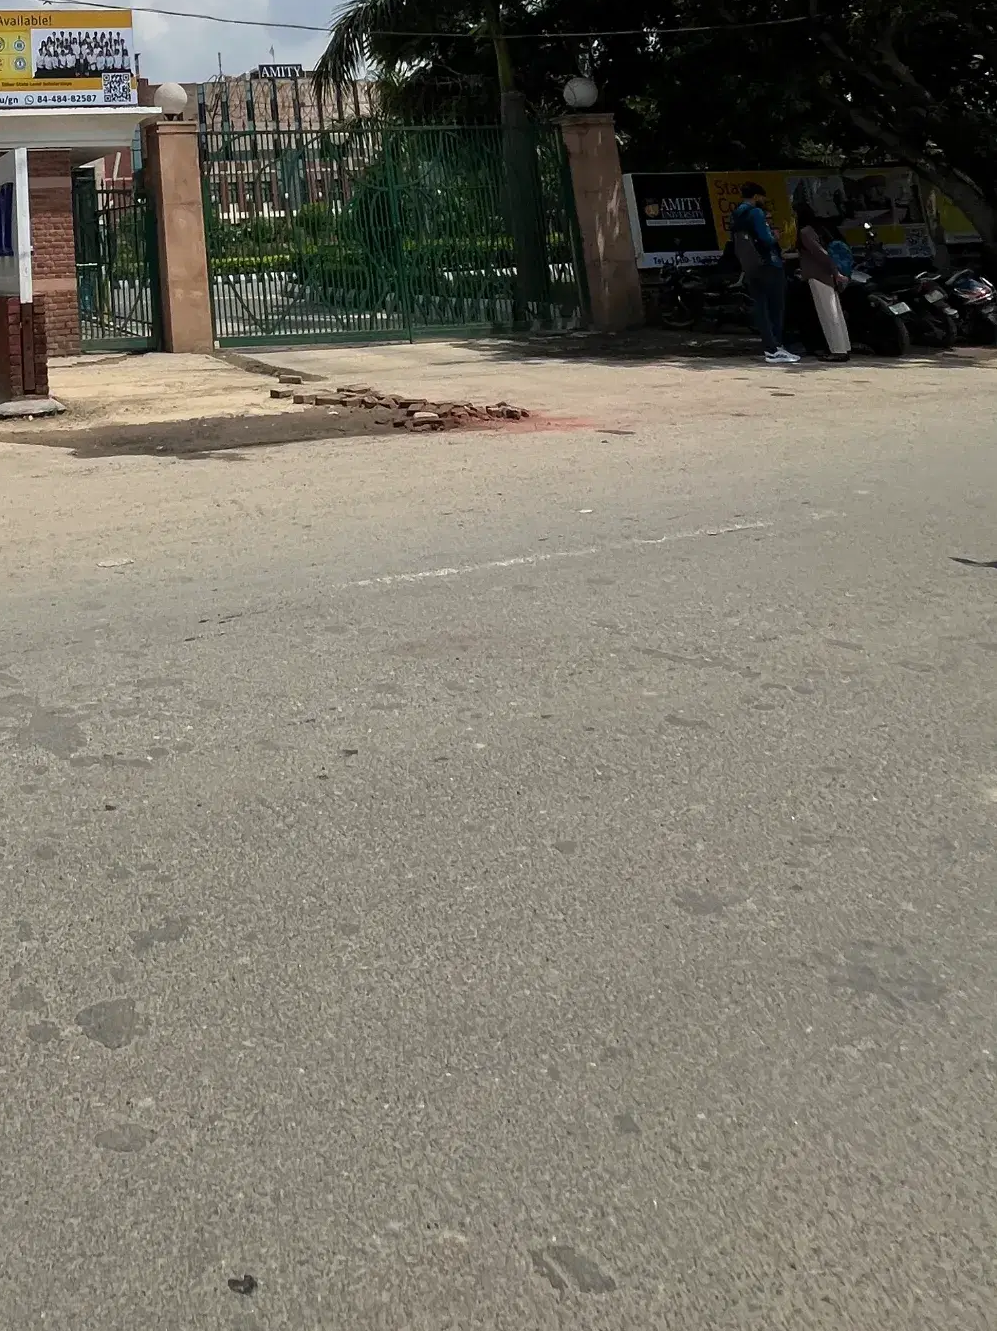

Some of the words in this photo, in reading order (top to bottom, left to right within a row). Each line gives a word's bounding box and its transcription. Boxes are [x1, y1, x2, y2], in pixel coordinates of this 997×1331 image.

[261, 65, 301, 78] AMITY
[37, 94, 97, 104] 84-484-82587
[660, 197, 702, 211] AMITY
[661, 210, 704, 219] UNIVERSITY
